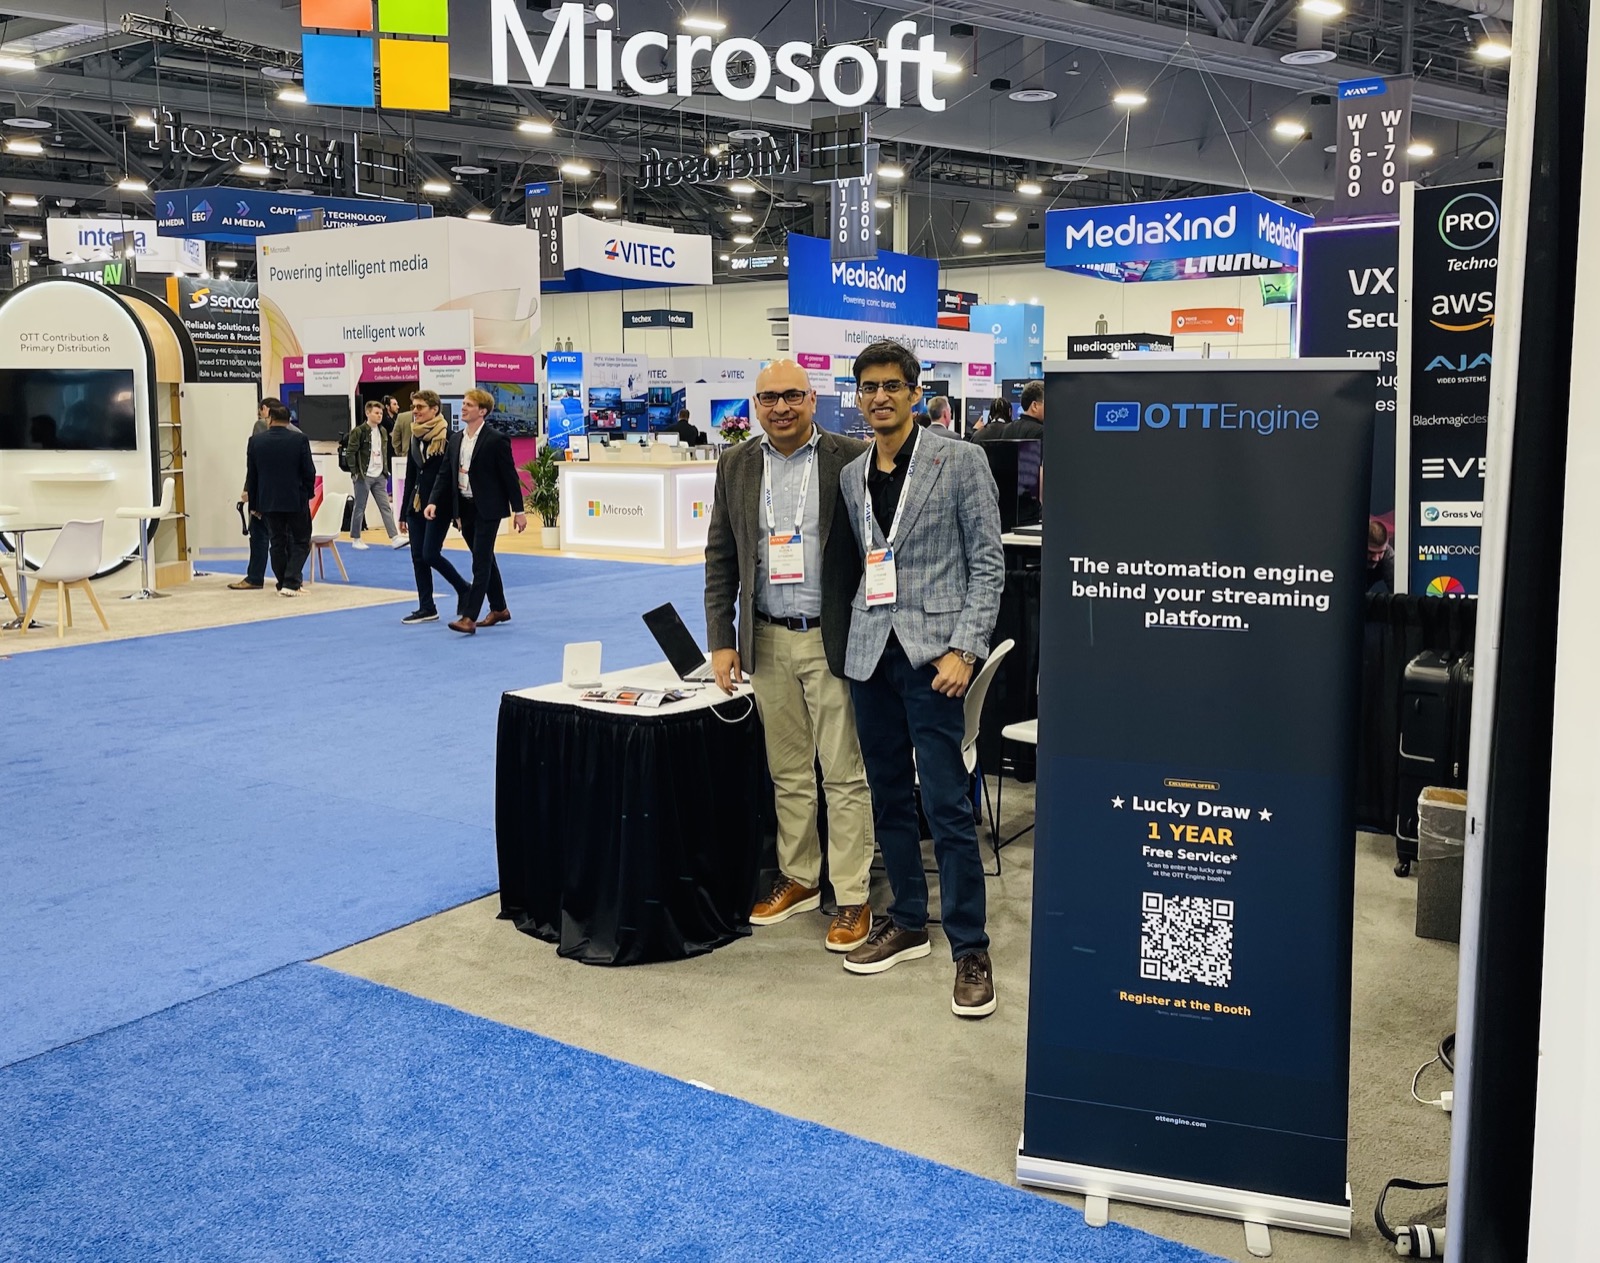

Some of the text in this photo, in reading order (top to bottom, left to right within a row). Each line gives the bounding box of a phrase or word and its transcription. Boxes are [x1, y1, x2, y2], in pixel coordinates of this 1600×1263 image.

[491, 0, 948, 112] Microsoft
[1346, 113, 1368, 198] W1600
[1380, 110, 1403, 195] W1700
[165, 218, 185, 227] MEDIA
[191, 212, 206, 222] EEG
[221, 217, 266, 229] AI MEDIA
[328, 211, 387, 223] TECHNOLOGY
[1445, 210, 1495, 233] PRO
[547, 205, 559, 265] W1900
[1065, 205, 1237, 250] MediaKind
[78, 225, 146, 247] intea
[620, 241, 676, 269] VITEC
[269, 253, 429, 283] Powering intelligent media
[1446, 256, 1498, 272] Techno
[831, 262, 907, 294] MediaKind
[842, 294, 897, 310] Powering iconic brands
[1431, 291, 1494, 316] aws
[184, 320, 216, 330] Reliable
[217, 322, 251, 332] Solutions
[631, 315, 652, 324] techex
[19, 332, 110, 342] OTT Contribution &
[190, 332, 229, 340] ontribution
[342, 322, 426, 343] Intelligent work
[20, 343, 111, 355] Primary Distribution
[911, 333, 959, 352] orchestration
[1073, 339, 1137, 353] mediagenix
[427, 354, 443, 363] Copilot
[448, 354, 462, 362] agents
[1423, 353, 1493, 372] AJA
[382, 365, 400, 373] entirely
[727, 371, 745, 380] VITEC
[1436, 375, 1487, 384] VIDEO SYSTEMS
[1144, 402, 1320, 436] OTTEngine
[602, 503, 644, 517] Microsoft
[1442, 509, 1468, 519] Grass
[1069, 557, 1335, 585] The automation engine
[1071, 580, 1331, 612] behind your streaming
[1144, 608, 1250, 629] platform.
[1132, 795, 1251, 820] Lucky Draw
[1147, 822, 1235, 847] 1 YEAR
[1142, 845, 1174, 859] Free
[1146, 861, 1162, 869] Scan
[1199, 866, 1215, 875] lucky
[1216, 868, 1232, 876] draw
[1185, 873, 1206, 881] Engine
[1207, 875, 1226, 883] booth
[1119, 990, 1172, 1006] Register
[1173, 999, 1188, 1009] at
[1189, 1000, 1211, 1011] the
[1214, 1002, 1251, 1016] Booth
[1155, 1114, 1207, 1128] ottengine.com
